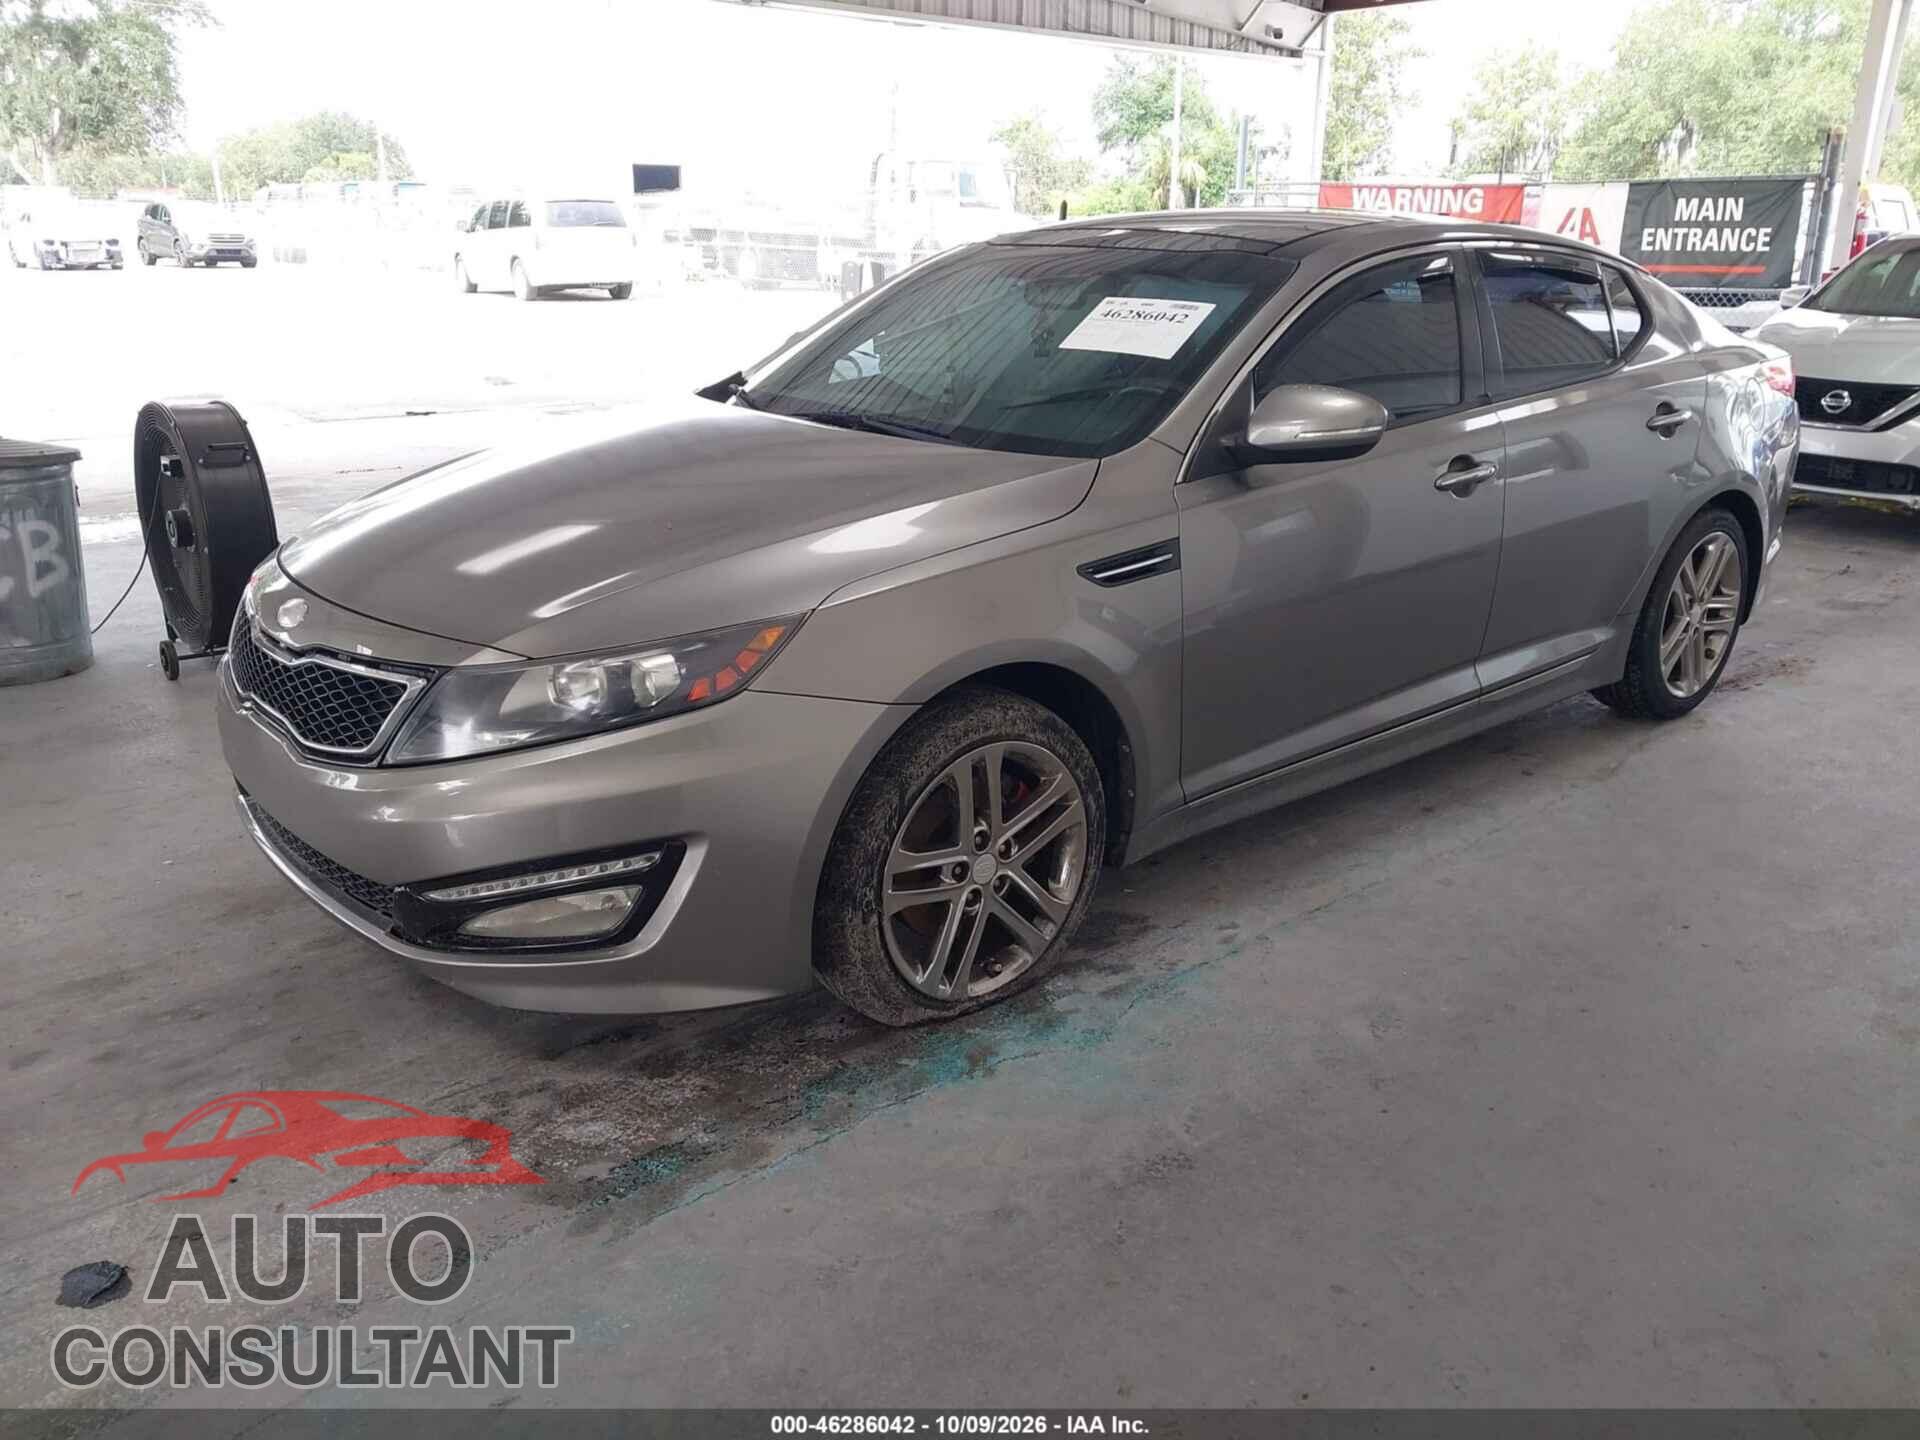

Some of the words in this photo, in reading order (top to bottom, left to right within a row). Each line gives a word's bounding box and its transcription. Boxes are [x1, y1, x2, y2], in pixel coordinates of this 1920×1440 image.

[1352, 187, 1484, 214] WARNING
[1674, 197, 1744, 222] MAIN
[1641, 227, 1772, 252] ENTRANCE
[1101, 309, 1189, 324] 46286042
